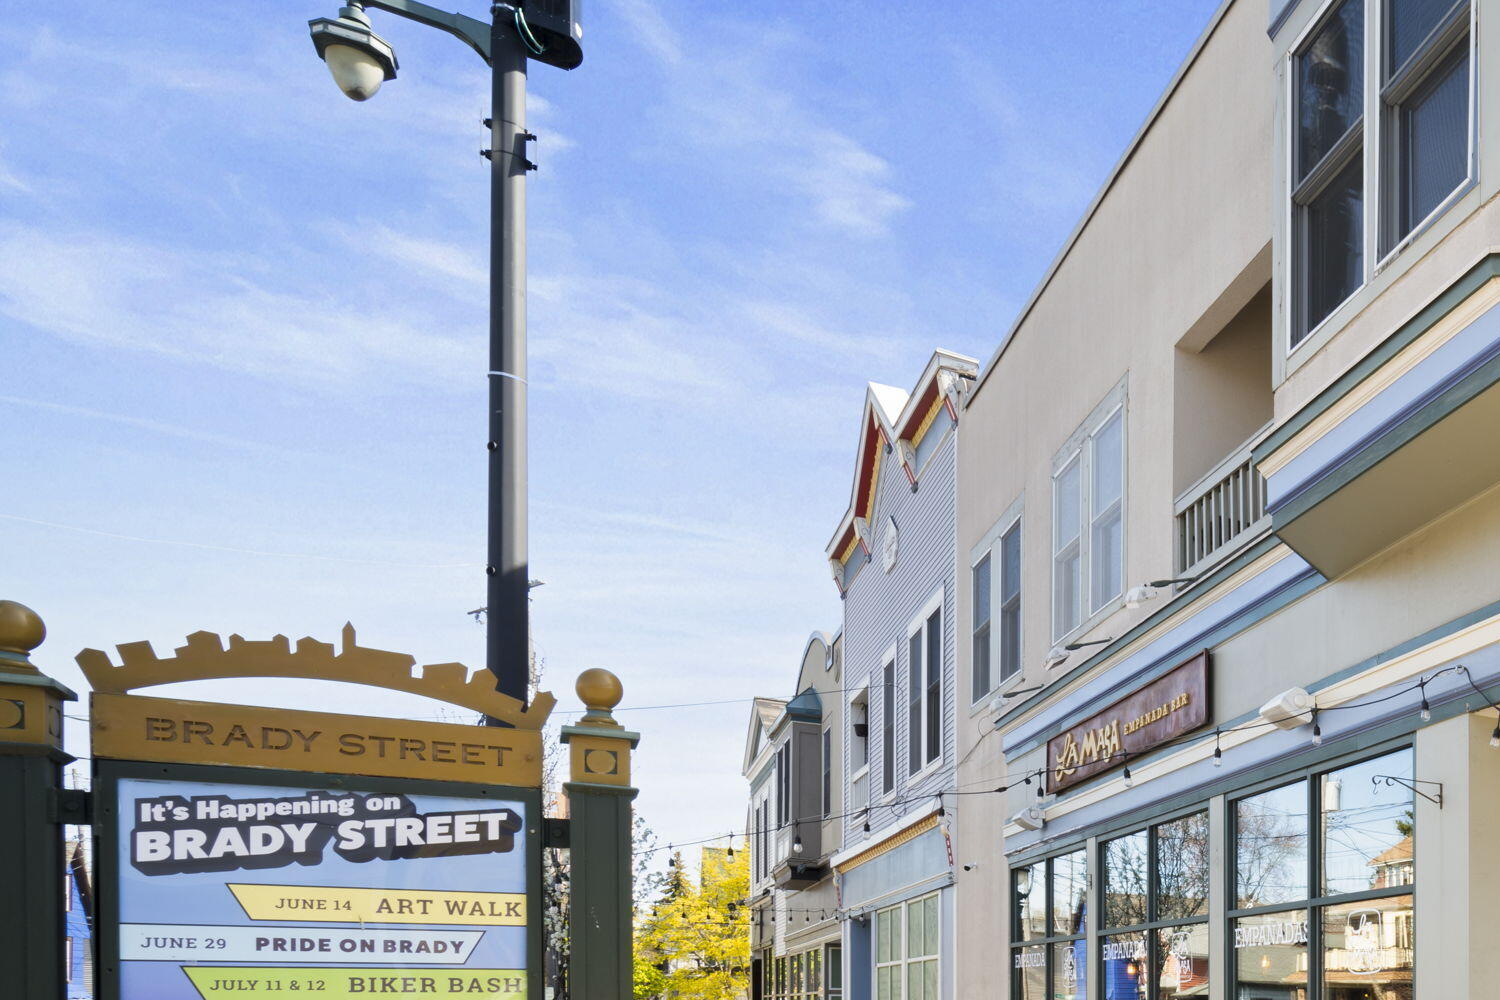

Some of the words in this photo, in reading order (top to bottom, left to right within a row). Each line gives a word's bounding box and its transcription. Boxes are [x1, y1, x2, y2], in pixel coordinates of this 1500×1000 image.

[145, 717, 321, 752] BRADY
[339, 734, 513, 767] STREET
[1055, 733, 1079, 781] LA
[1079, 720, 1120, 763] MASA
[1124, 704, 1170, 735] EMPANADA
[1171, 692, 1190, 712] BAR
[197, 796, 355, 821] Happening
[366, 796, 401, 813] on
[136, 823, 318, 862] BRADY
[339, 813, 508, 850] STREET
[275, 898, 328, 911] JUNE
[333, 900, 352, 912] 14
[376, 898, 433, 915] ART
[446, 900, 523, 918] WALK
[141, 937, 198, 950] JUNE
[205, 937, 227, 950] 29
[256, 938, 331, 953] PRIDE
[340, 938, 375, 953] ON
[383, 940, 465, 954] BRADY
[210, 979, 259, 991] JULY
[266, 979, 282, 991] 11
[290, 979, 300, 991] &
[307, 979, 326, 991] 12
[348, 977, 437, 993] BIKER
[448, 977, 523, 993] BASH
